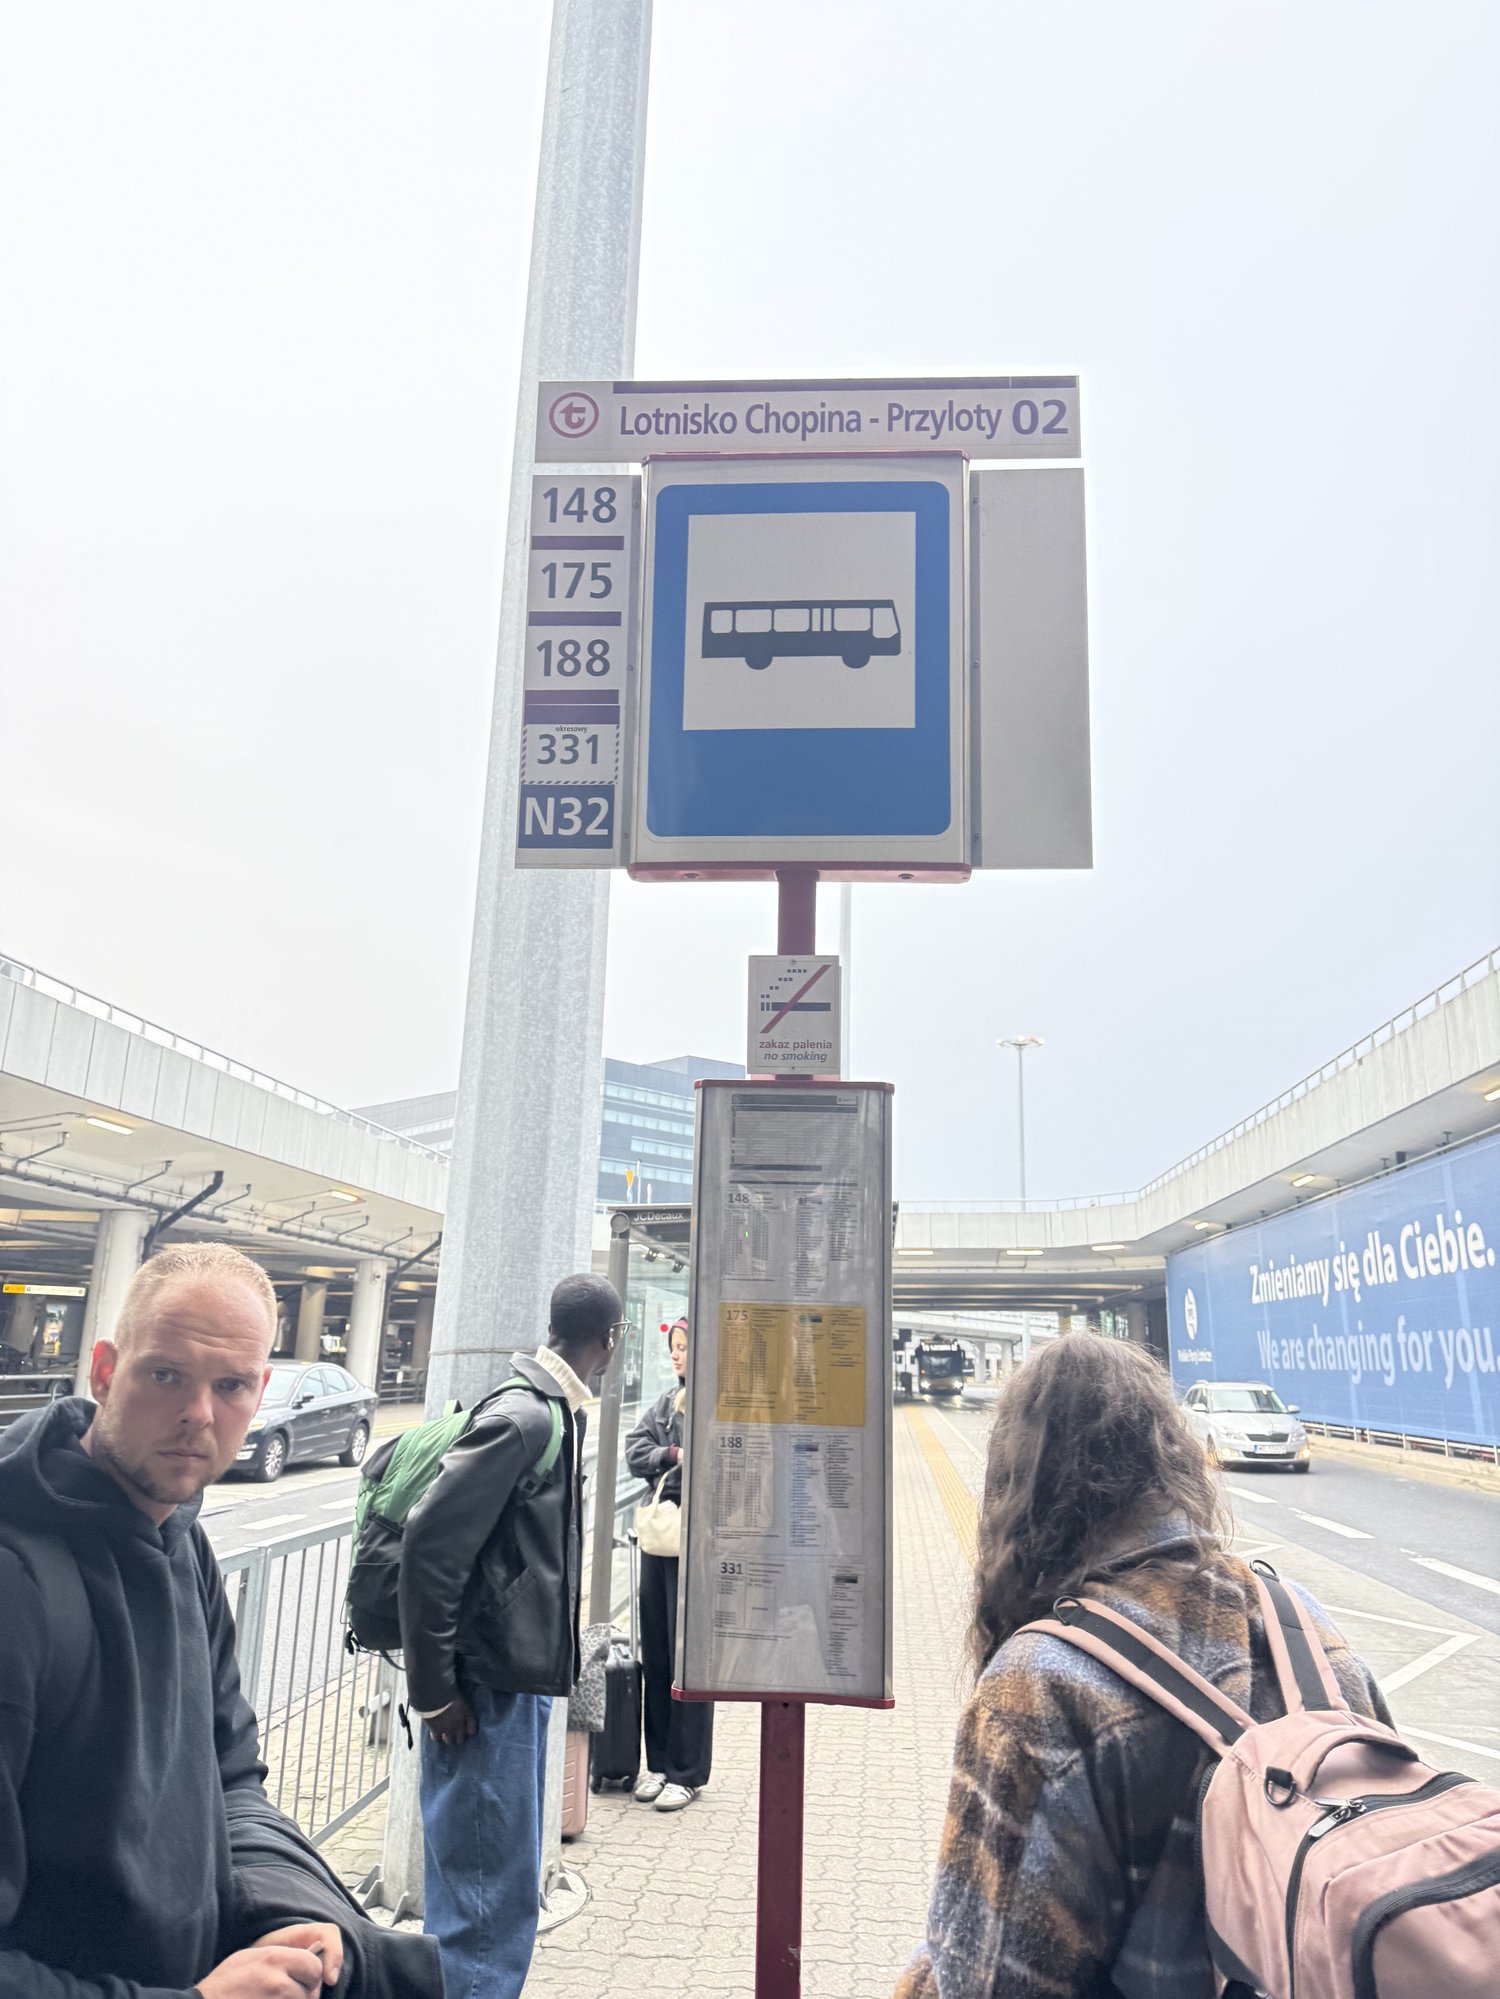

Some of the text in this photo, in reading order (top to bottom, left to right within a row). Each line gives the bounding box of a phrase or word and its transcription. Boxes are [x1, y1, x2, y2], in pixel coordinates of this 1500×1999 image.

[620, 403, 738, 436] Lotnisko
[745, 402, 862, 442] Chopina
[887, 399, 1002, 441] Przyloty
[1012, 399, 1069, 435] 02
[542, 486, 618, 524] 148
[540, 562, 613, 599] 175
[535, 639, 612, 677] 188
[555, 725, 588, 733] okresowy
[537, 733, 599, 765] 331
[524, 797, 609, 836] N32
[759, 1040, 833, 1051] zakaz palenia
[764, 1051, 828, 1063] no smoking
[727, 1193, 750, 1204] 148
[633, 1211, 684, 1221] JCDecaux
[1250, 1209, 1496, 1307] Zmieniamy się dla Ciebie.
[726, 1310, 748, 1321] 175
[1257, 1329, 1279, 1371] We
[1281, 1337, 1305, 1371] are
[1307, 1320, 1396, 1387] changing
[1397, 1315, 1433, 1373] for
[720, 1436, 743, 1449] 188
[720, 1562, 744, 1575] 331
